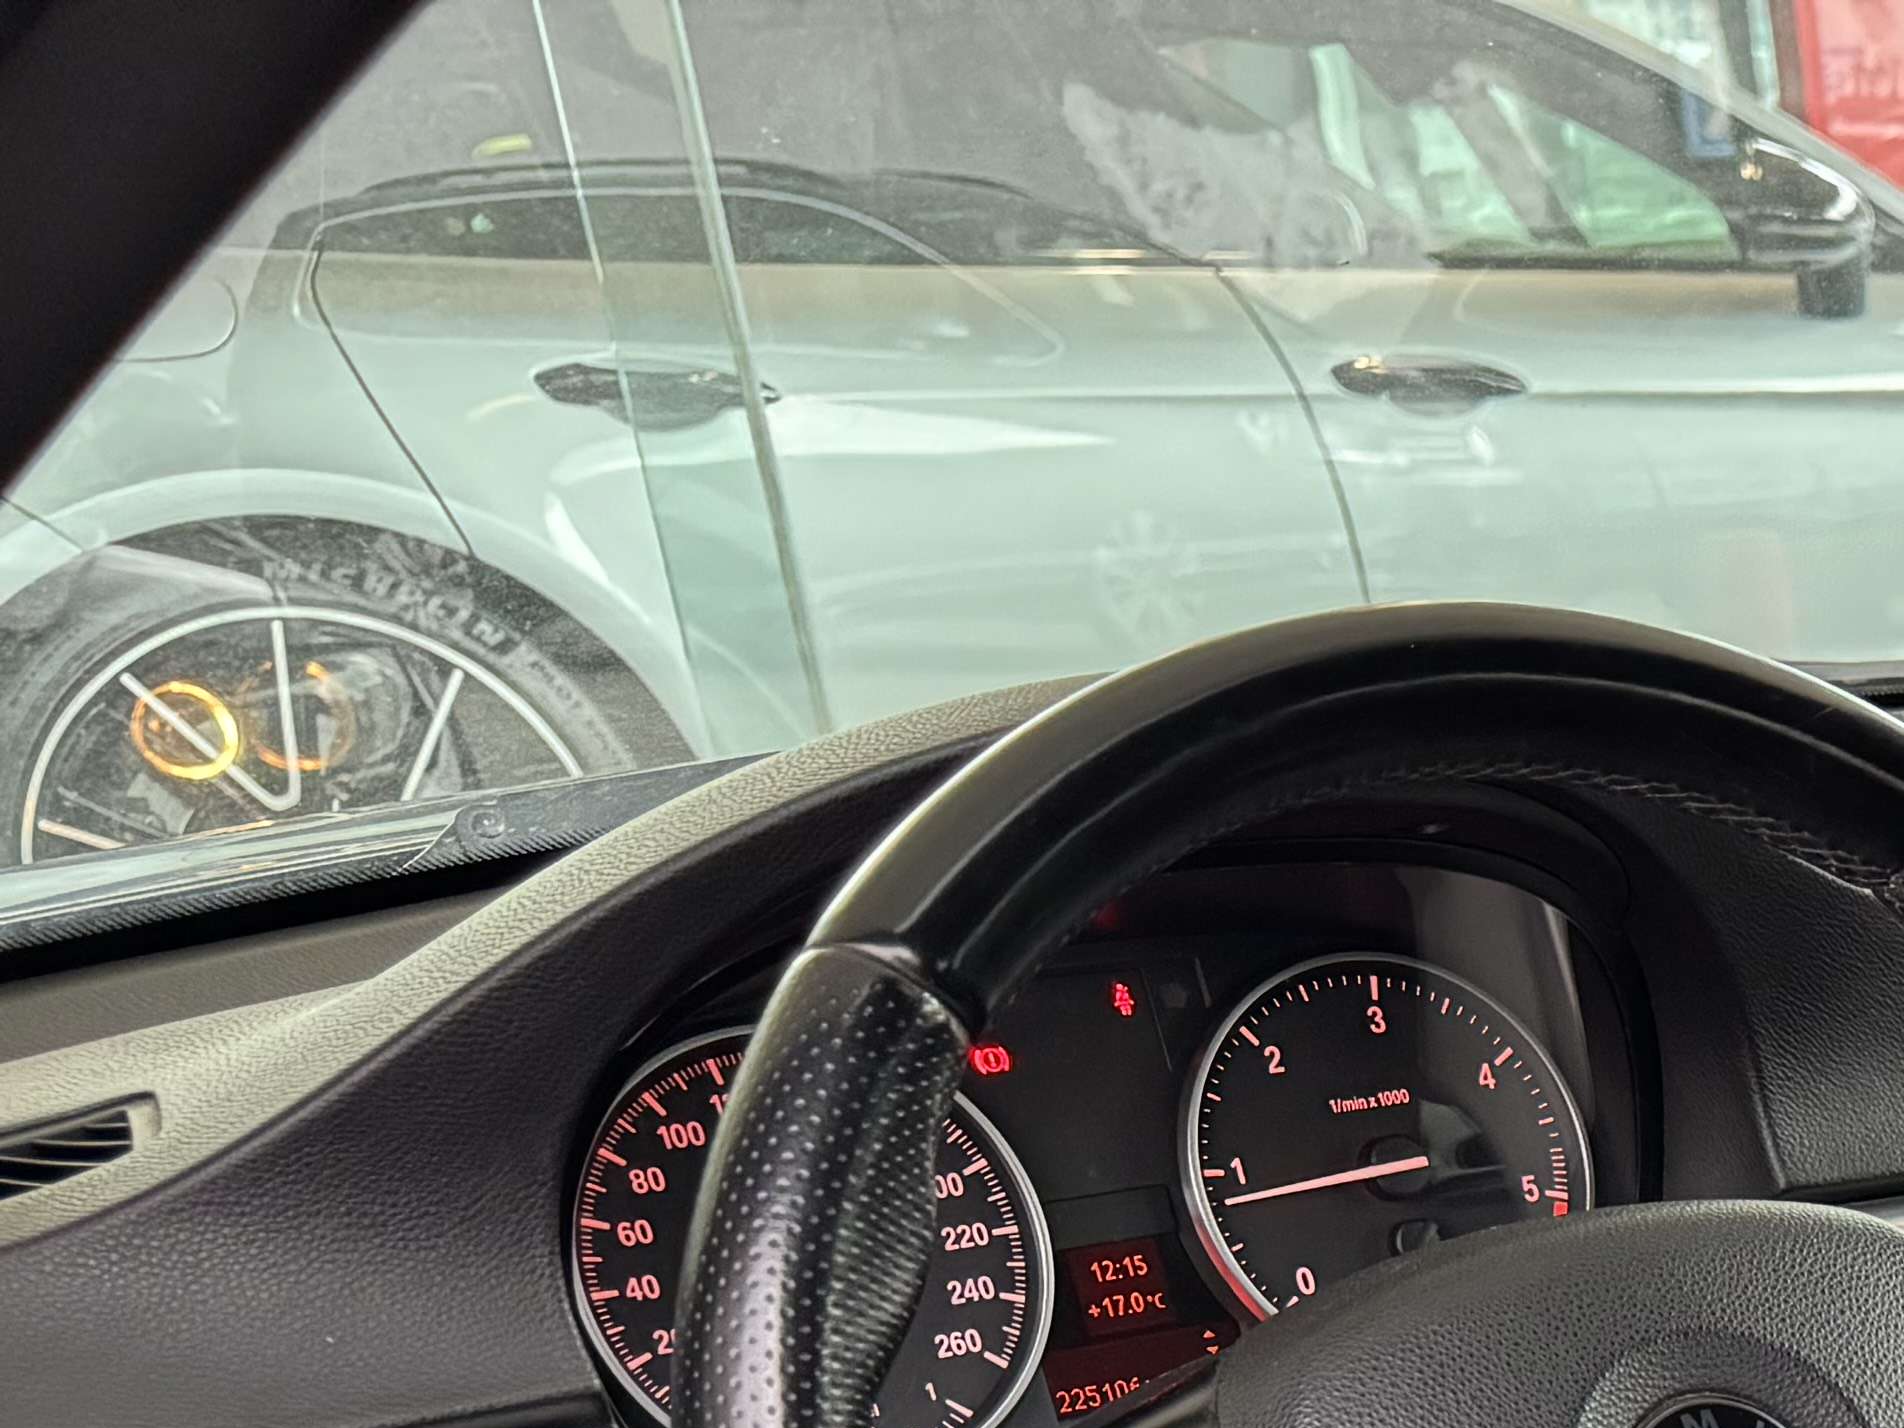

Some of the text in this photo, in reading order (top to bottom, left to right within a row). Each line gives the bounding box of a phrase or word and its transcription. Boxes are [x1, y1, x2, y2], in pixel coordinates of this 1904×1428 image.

[1366, 1005, 1387, 1034] 3
[1263, 1045, 1286, 1075] 2
[1478, 1062, 1497, 1090] 4
[1377, 1088, 1410, 1107] 1000
[656, 1121, 707, 1150] 100
[628, 1166, 667, 1195] 80
[1229, 1157, 1247, 1185] 1
[1520, 1175, 1541, 1203] 5
[616, 1219, 655, 1248] 60
[940, 1222, 990, 1251] 220
[1090, 1254, 1149, 1283] 12:15
[1295, 1266, 1316, 1296] 0
[625, 1274, 661, 1301] 40
[946, 1275, 996, 1306] 240
[651, 1328, 676, 1356] 2
[934, 1328, 983, 1359] 260
[924, 1382, 937, 1401] 1
